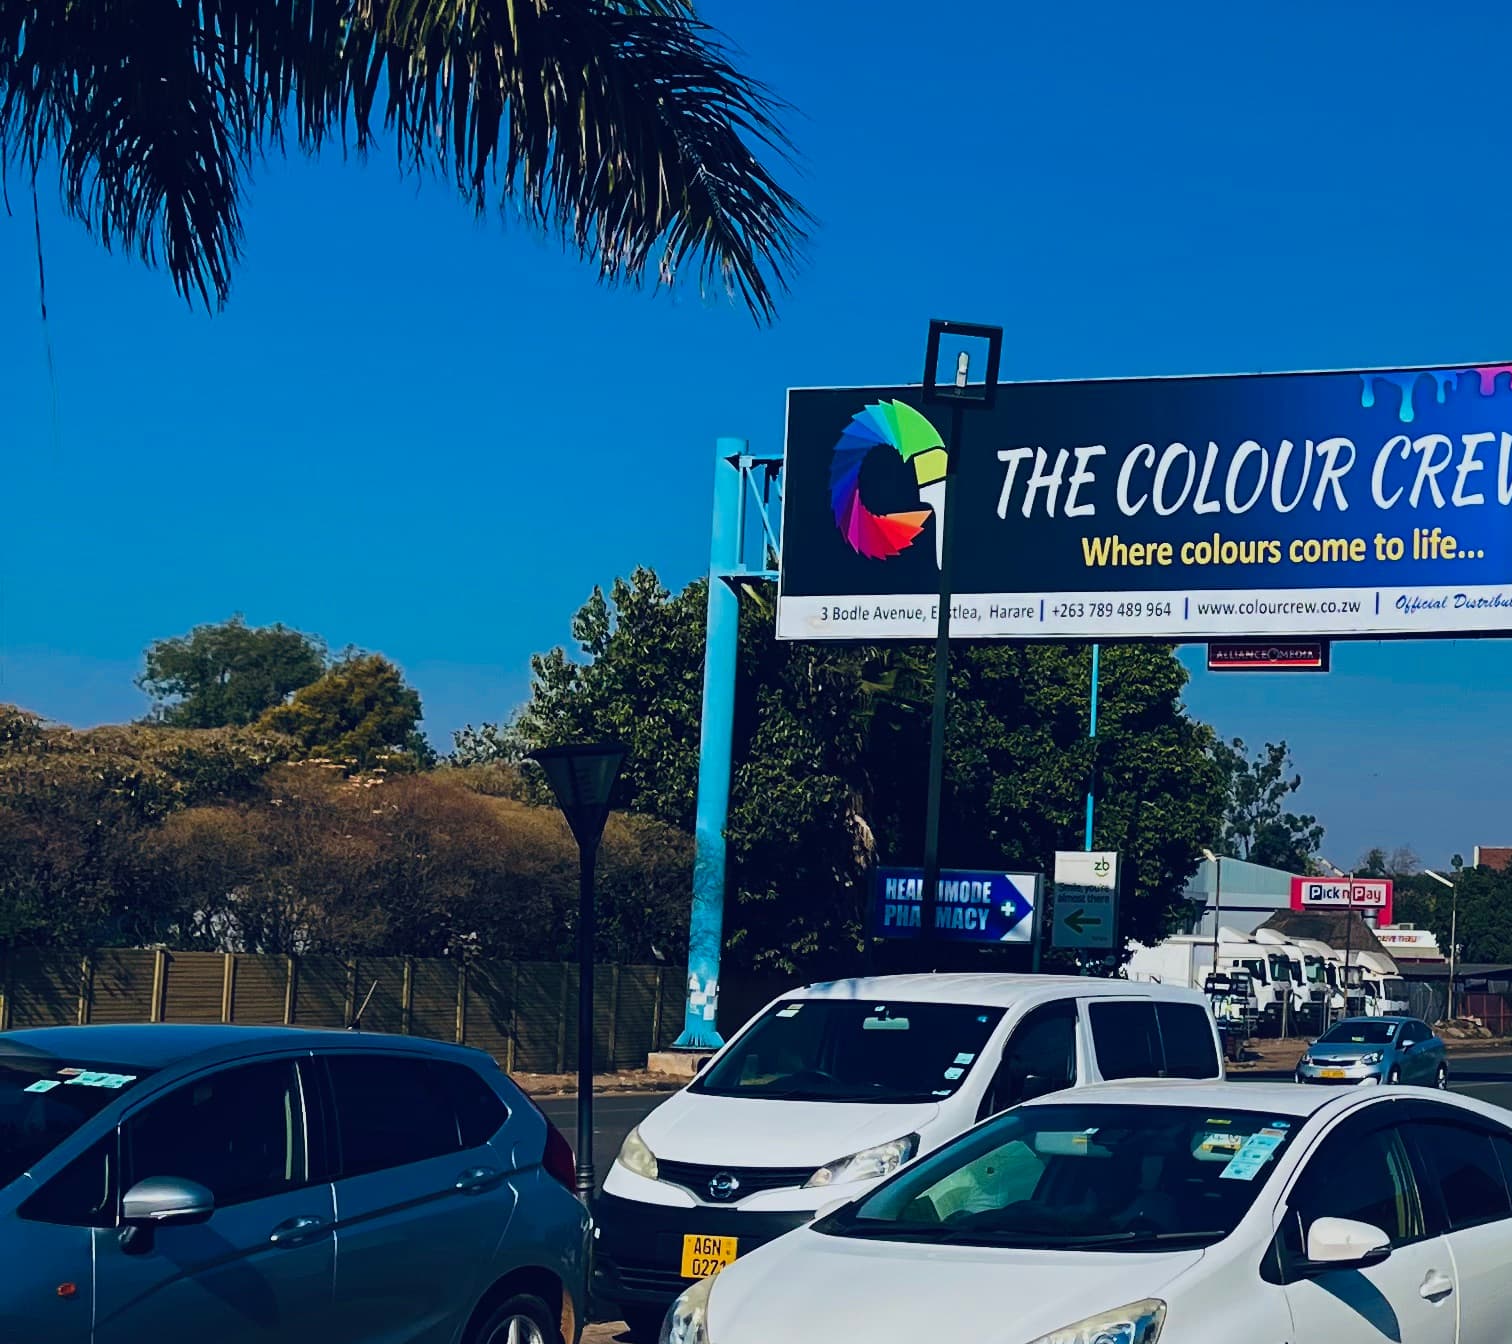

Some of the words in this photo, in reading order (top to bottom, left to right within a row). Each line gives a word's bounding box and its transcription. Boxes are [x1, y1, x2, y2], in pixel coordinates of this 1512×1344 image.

[996, 444, 1107, 520] THE
[1117, 436, 1357, 518] COLOUR
[1081, 535, 1174, 567] Where
[1180, 532, 1282, 565] colours
[1289, 536, 1367, 564] come
[1373, 533, 1405, 561] to
[1413, 527, 1485, 560] life...
[821, 607, 828, 621] 3
[832, 605, 870, 621] Bodle
[873, 605, 927, 622] Avenue,
[931, 604, 982, 622] Etlea,
[989, 604, 1035, 619] Harare
[1052, 603, 1084, 618] +263
[1089, 602, 1113, 617] 789
[1117, 602, 1142, 617] 489
[1146, 602, 1171, 616] 964
[1198, 599, 1361, 614] www.colourcrew.co.zw
[1395, 594, 1448, 614] Official
[1216, 650, 1268, 659] ALLIANCE
[1279, 649, 1314, 659] MEDIA
[1094, 856, 1110, 871] zb
[885, 878, 992, 904] HEALMODE
[1310, 885, 1339, 901] Pick
[1343, 889, 1351, 899] n
[1353, 886, 1382, 903] Pay
[884, 904, 990, 930] PHAMACY
[694, 1237, 722, 1256] AGN
